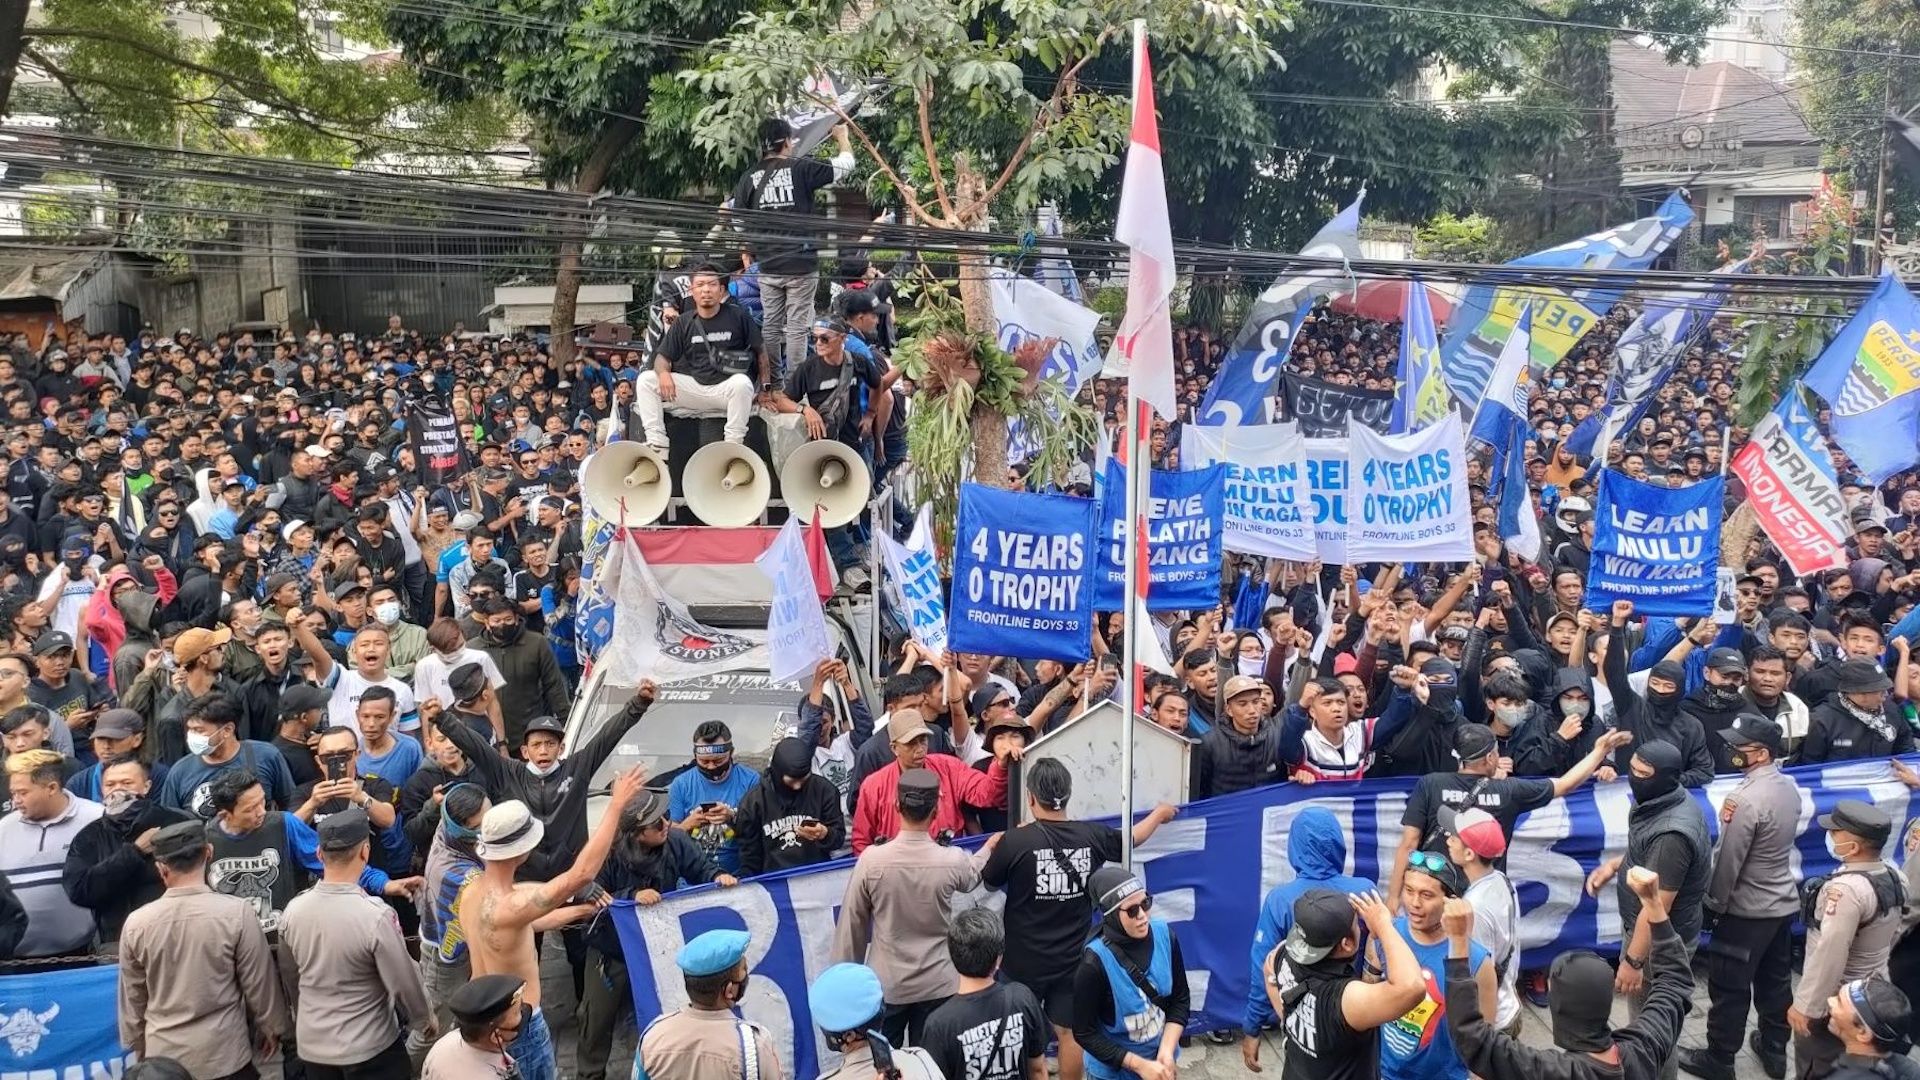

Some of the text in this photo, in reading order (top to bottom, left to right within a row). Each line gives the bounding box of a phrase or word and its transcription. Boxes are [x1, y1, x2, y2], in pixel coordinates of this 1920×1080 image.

[1363, 448, 1451, 491] 4 YEARS
[1149, 494, 1204, 520] ENE
[1252, 506, 1302, 523] KAGA
[1363, 483, 1452, 525] 0 TROPHY
[1112, 517, 1212, 544] PLATIH
[1266, 526, 1291, 538] BOYS
[1292, 528, 1303, 538] 33
[1362, 522, 1456, 541] FRONTLINE BOYS 33
[1611, 503, 1709, 535] LEARN
[971, 527, 1084, 570] 4 YEARS
[1111, 541, 1209, 567] UANG
[1617, 533, 1703, 561] MULU
[1168, 570, 1194, 582] BOYS
[1604, 554, 1704, 580] WIN KAGA
[968, 566, 1083, 611] 0 TROPHY
[968, 609, 1079, 632] FRONTLINE BOYS 33
[660, 690, 713, 701] TRANS
[218, 858, 271, 871] VIKING
